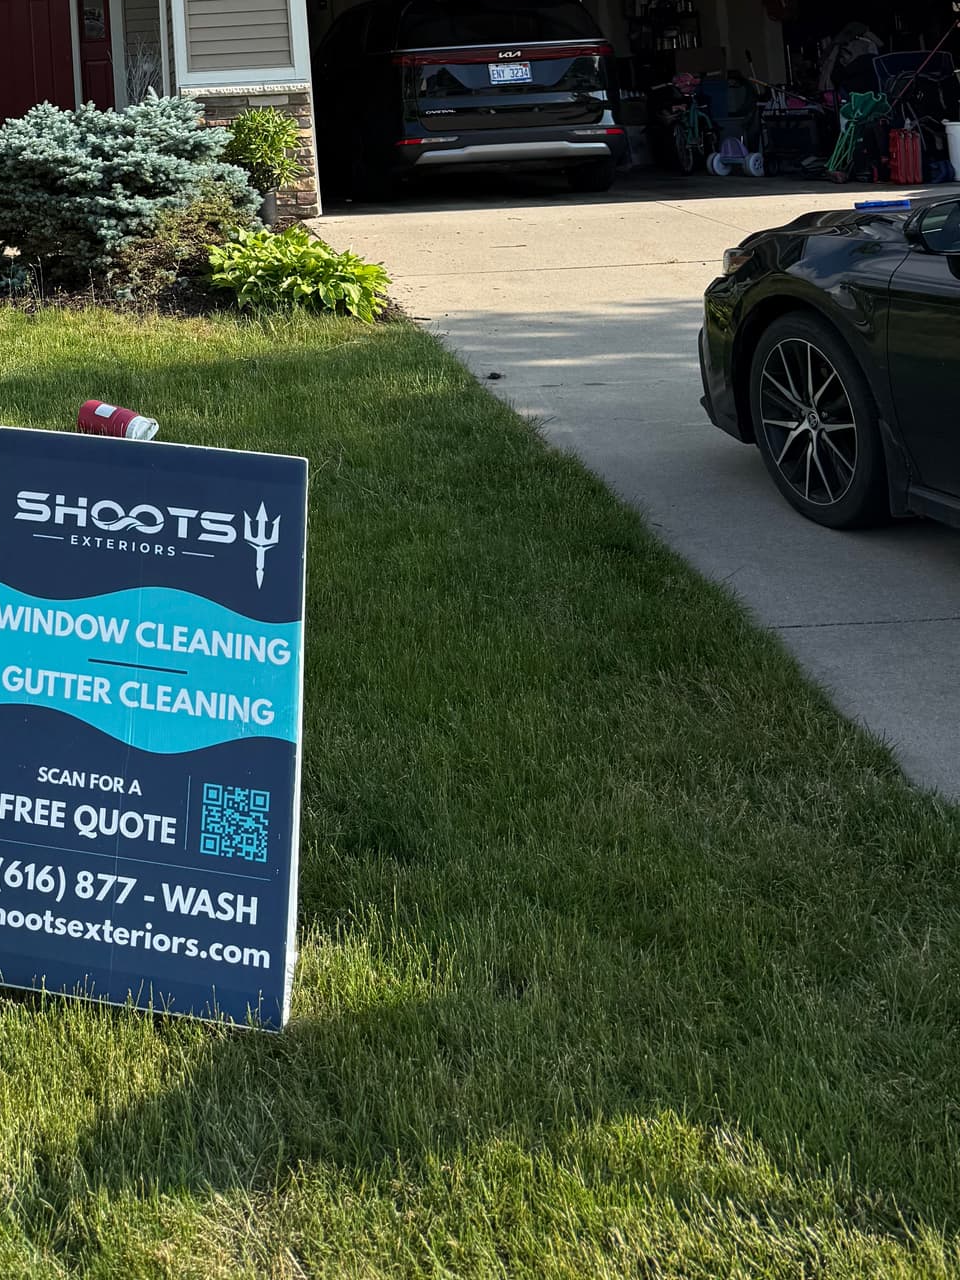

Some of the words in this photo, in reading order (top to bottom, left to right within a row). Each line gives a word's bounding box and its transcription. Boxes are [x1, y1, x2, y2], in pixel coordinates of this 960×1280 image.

[14, 490, 237, 544] SHOOTS
[70, 534, 176, 557] EXTERIORS
[135, 622, 291, 665] CLEANING
[1, 665, 112, 704] GUTTER
[119, 681, 275, 726] CLEANING
[38, 767, 86, 788] SCAN
[90, 774, 124, 794] FOR
[127, 779, 142, 796] A
[74, 804, 177, 845] QUOTE
[75, 870, 137, 904] 877
[161, 882, 258, 925] WASH
